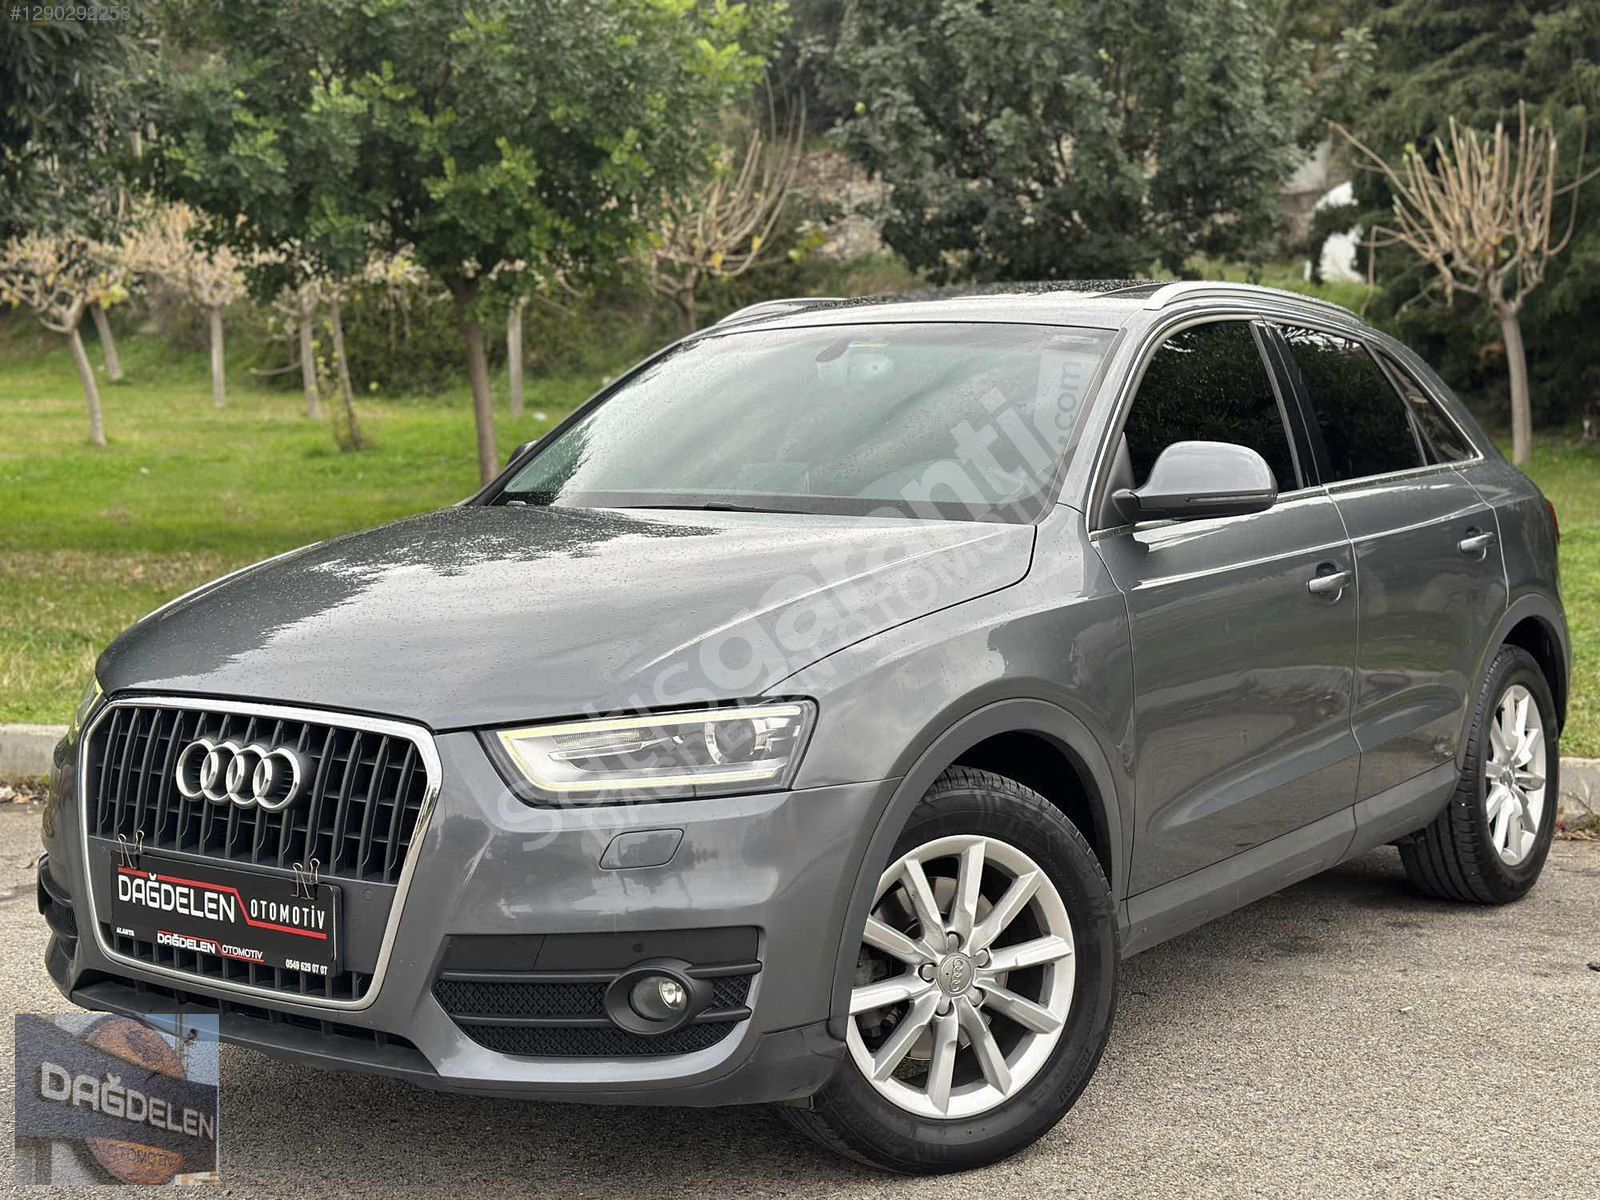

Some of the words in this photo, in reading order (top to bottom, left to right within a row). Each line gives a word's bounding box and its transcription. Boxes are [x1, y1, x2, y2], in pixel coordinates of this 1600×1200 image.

[118, 872, 235, 923] DAĞDELEN
[250, 898, 325, 929] OTOMOTİV
[157, 933, 216, 955] DAĞDELEN
[222, 944, 263, 960] OTOMOTİV
